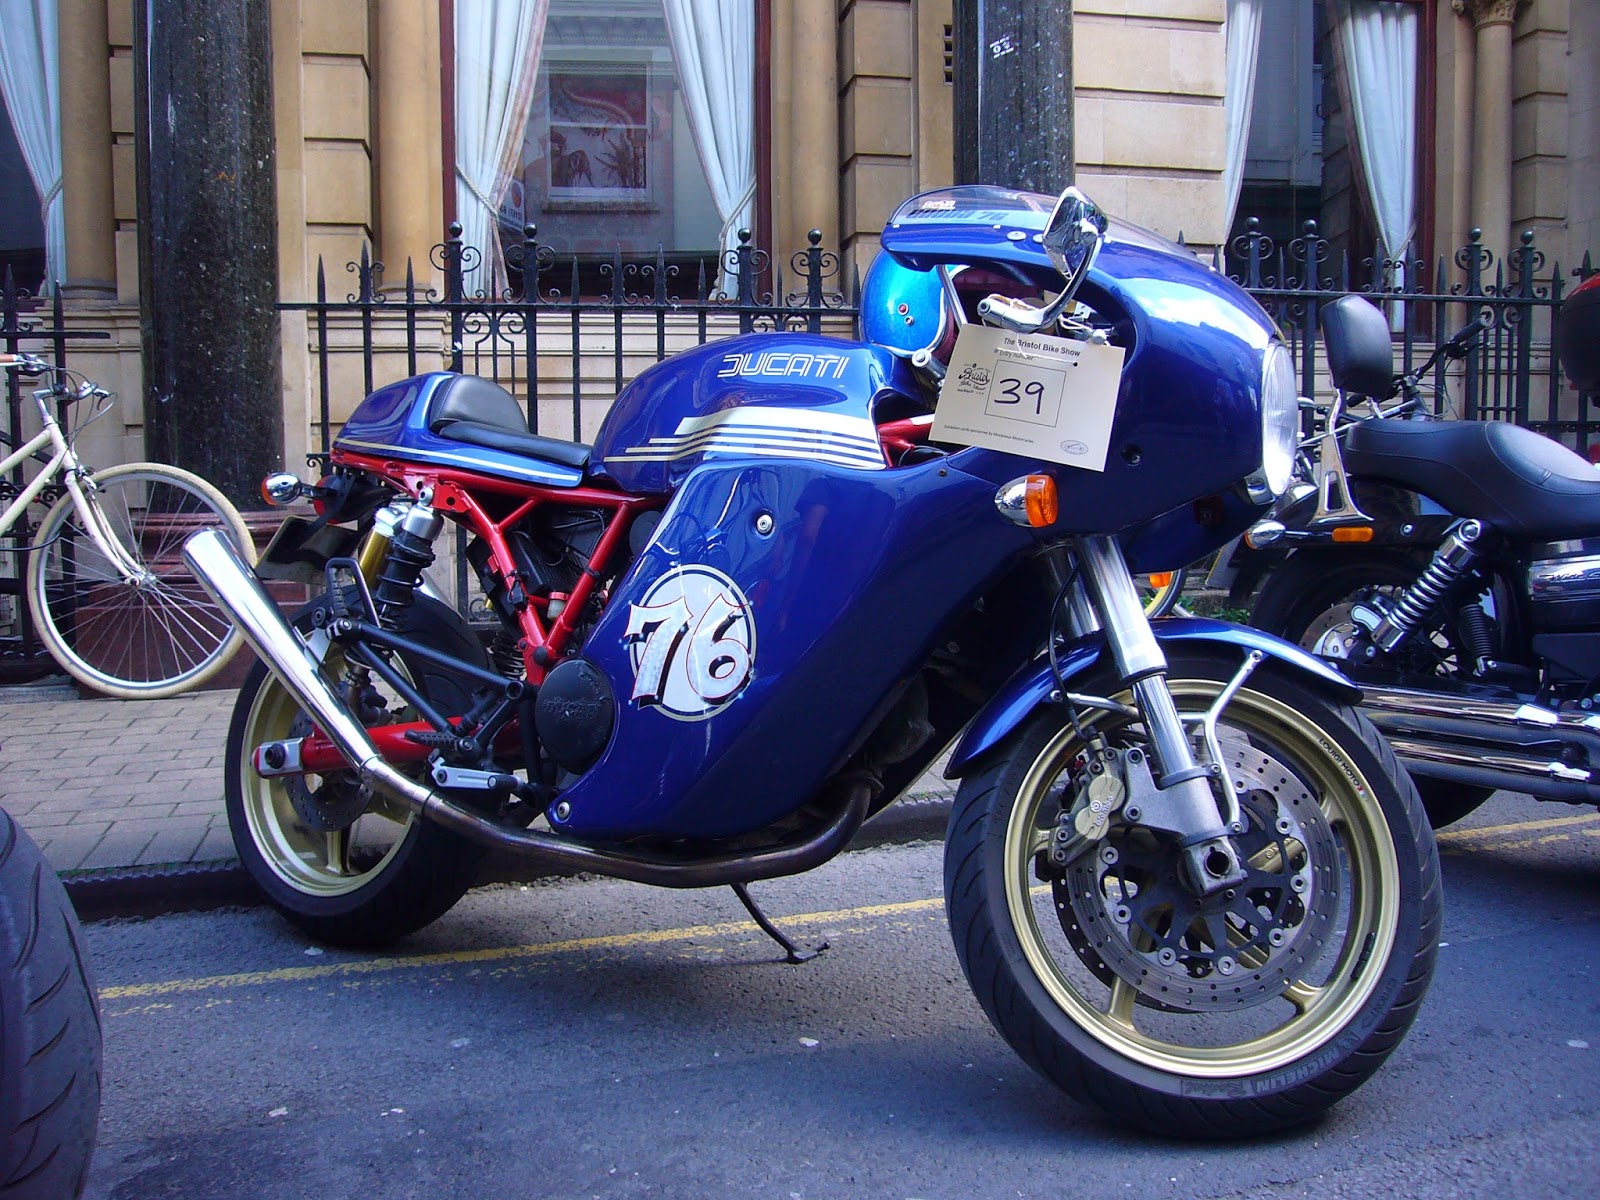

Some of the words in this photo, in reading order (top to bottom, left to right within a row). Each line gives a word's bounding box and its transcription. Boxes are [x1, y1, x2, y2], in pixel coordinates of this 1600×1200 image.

[1004, 337, 1015, 345] The
[1017, 339, 1041, 350] Bristol
[1042, 344, 1060, 353] Bike
[1060, 346, 1081, 357] Show
[717, 352, 850, 379] DUCATI
[994, 378, 1045, 415] 39
[623, 592, 752, 709] 76
[1092, 795, 1114, 827] brembo
[1255, 1046, 1341, 1093] MICHELIN
